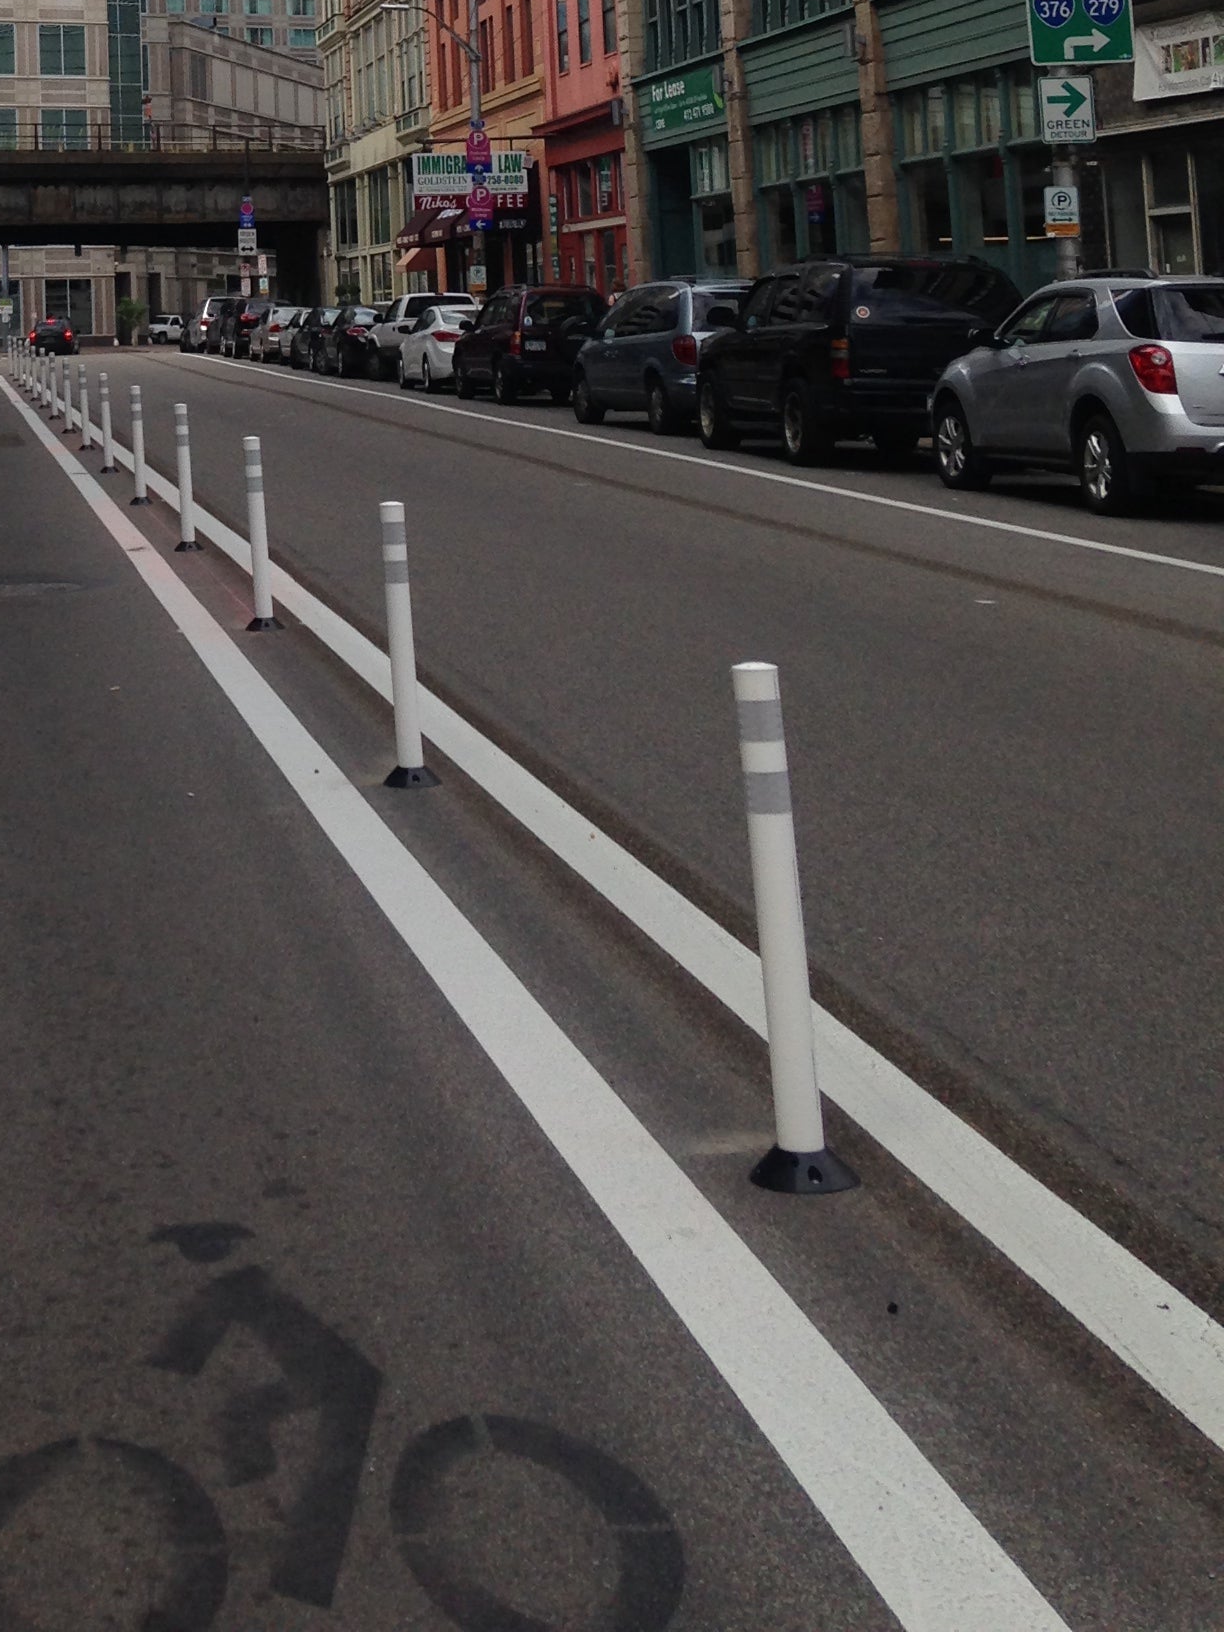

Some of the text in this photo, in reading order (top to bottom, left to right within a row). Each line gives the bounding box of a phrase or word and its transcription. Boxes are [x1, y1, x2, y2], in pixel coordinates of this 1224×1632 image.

[1040, 0, 1070, 18] 376
[652, 80, 685, 102] For Lease
[1047, 120, 1090, 130] GREEN
[1051, 131, 1087, 139] DETOUR
[417, 155, 468, 175] IMMIGRA
[498, 153, 522, 173] LAW
[417, 175, 467, 186] GOLDSTEIN
